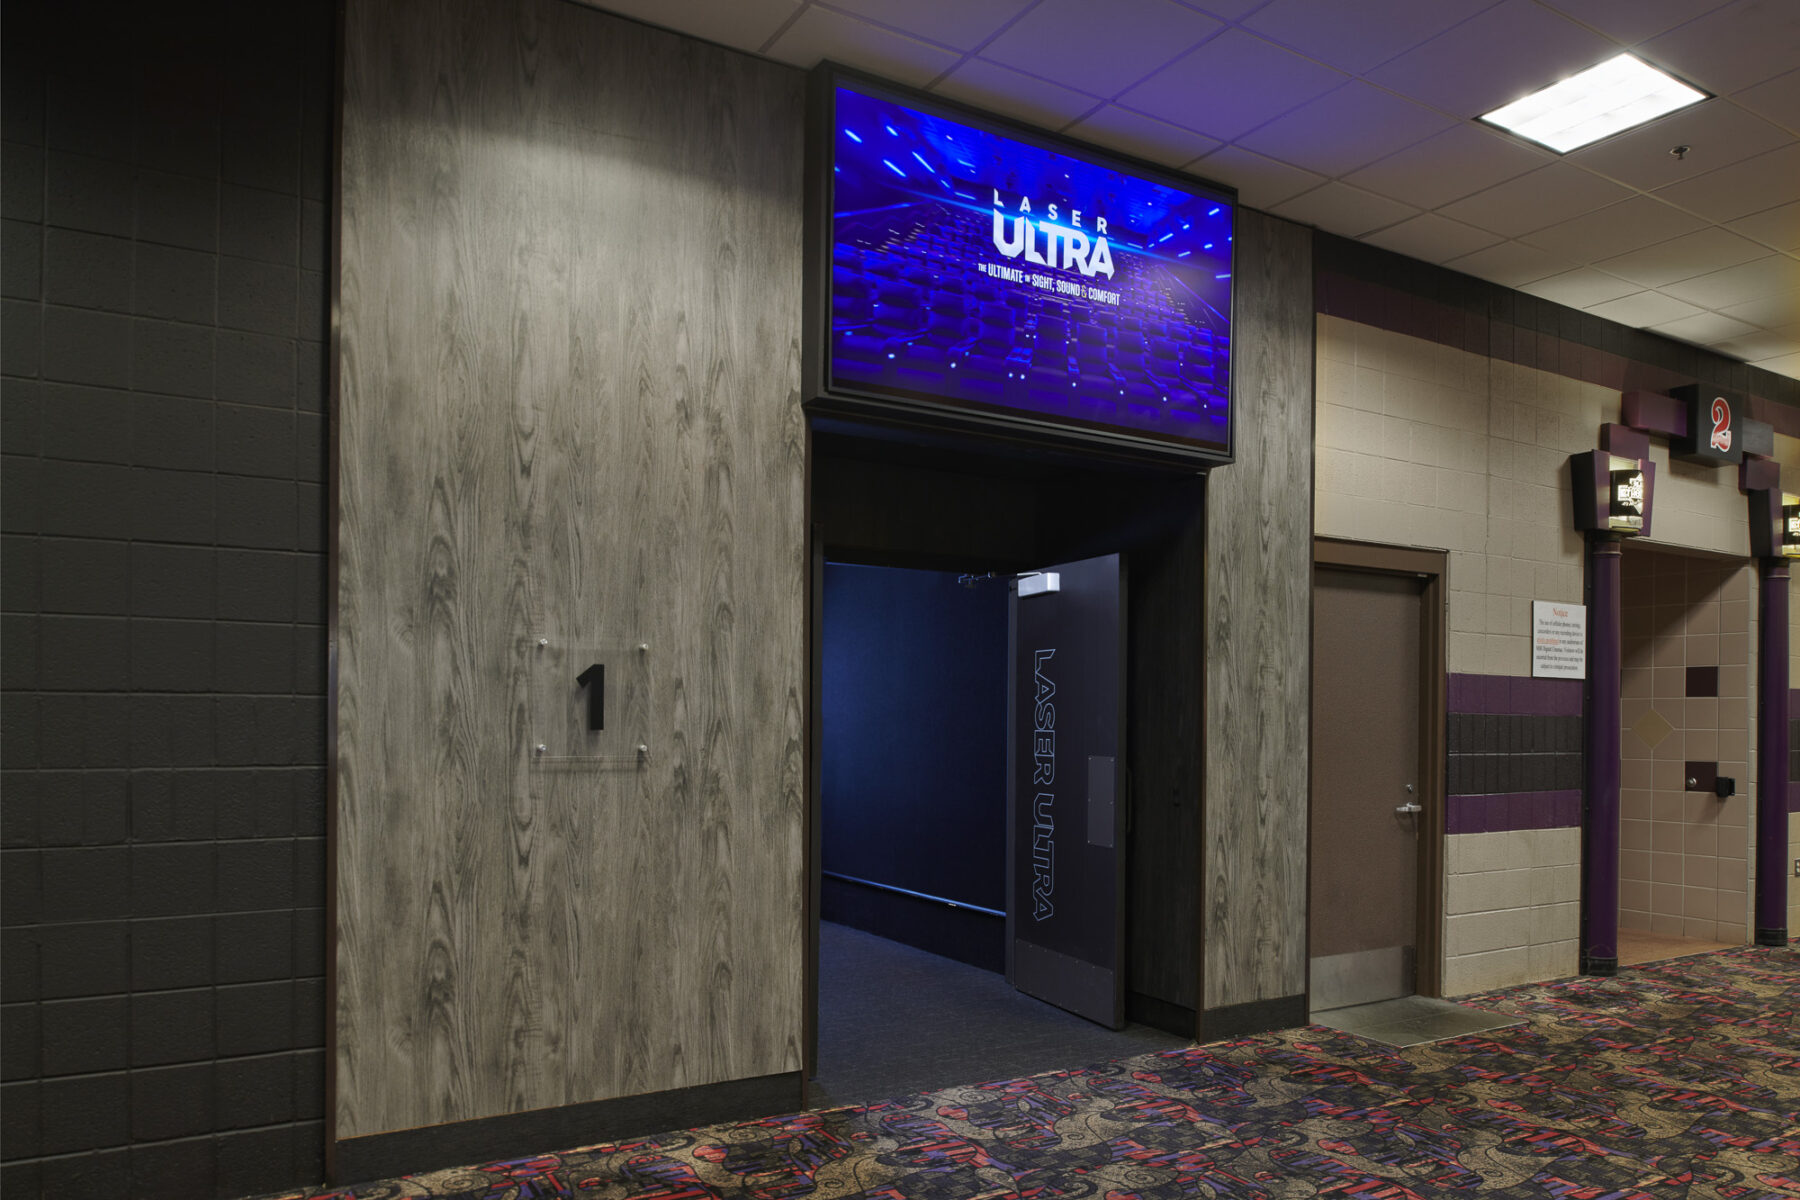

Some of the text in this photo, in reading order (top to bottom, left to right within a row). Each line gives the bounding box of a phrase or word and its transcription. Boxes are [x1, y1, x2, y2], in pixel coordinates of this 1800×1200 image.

[993, 188, 1108, 235] LASER
[992, 208, 1115, 281] ULTRA
[978, 263, 987, 272] THE
[988, 263, 1023, 284] ULTIMATE
[1032, 274, 1055, 293] SIGHT,
[1056, 280, 1080, 297] SOUND
[1081, 285, 1087, 298] &
[1088, 287, 1120, 306] COMFORT
[1711, 397, 1731, 452] 2
[576, 664, 604, 730] 1
[1033, 648, 1056, 922] LASER ULTRA
